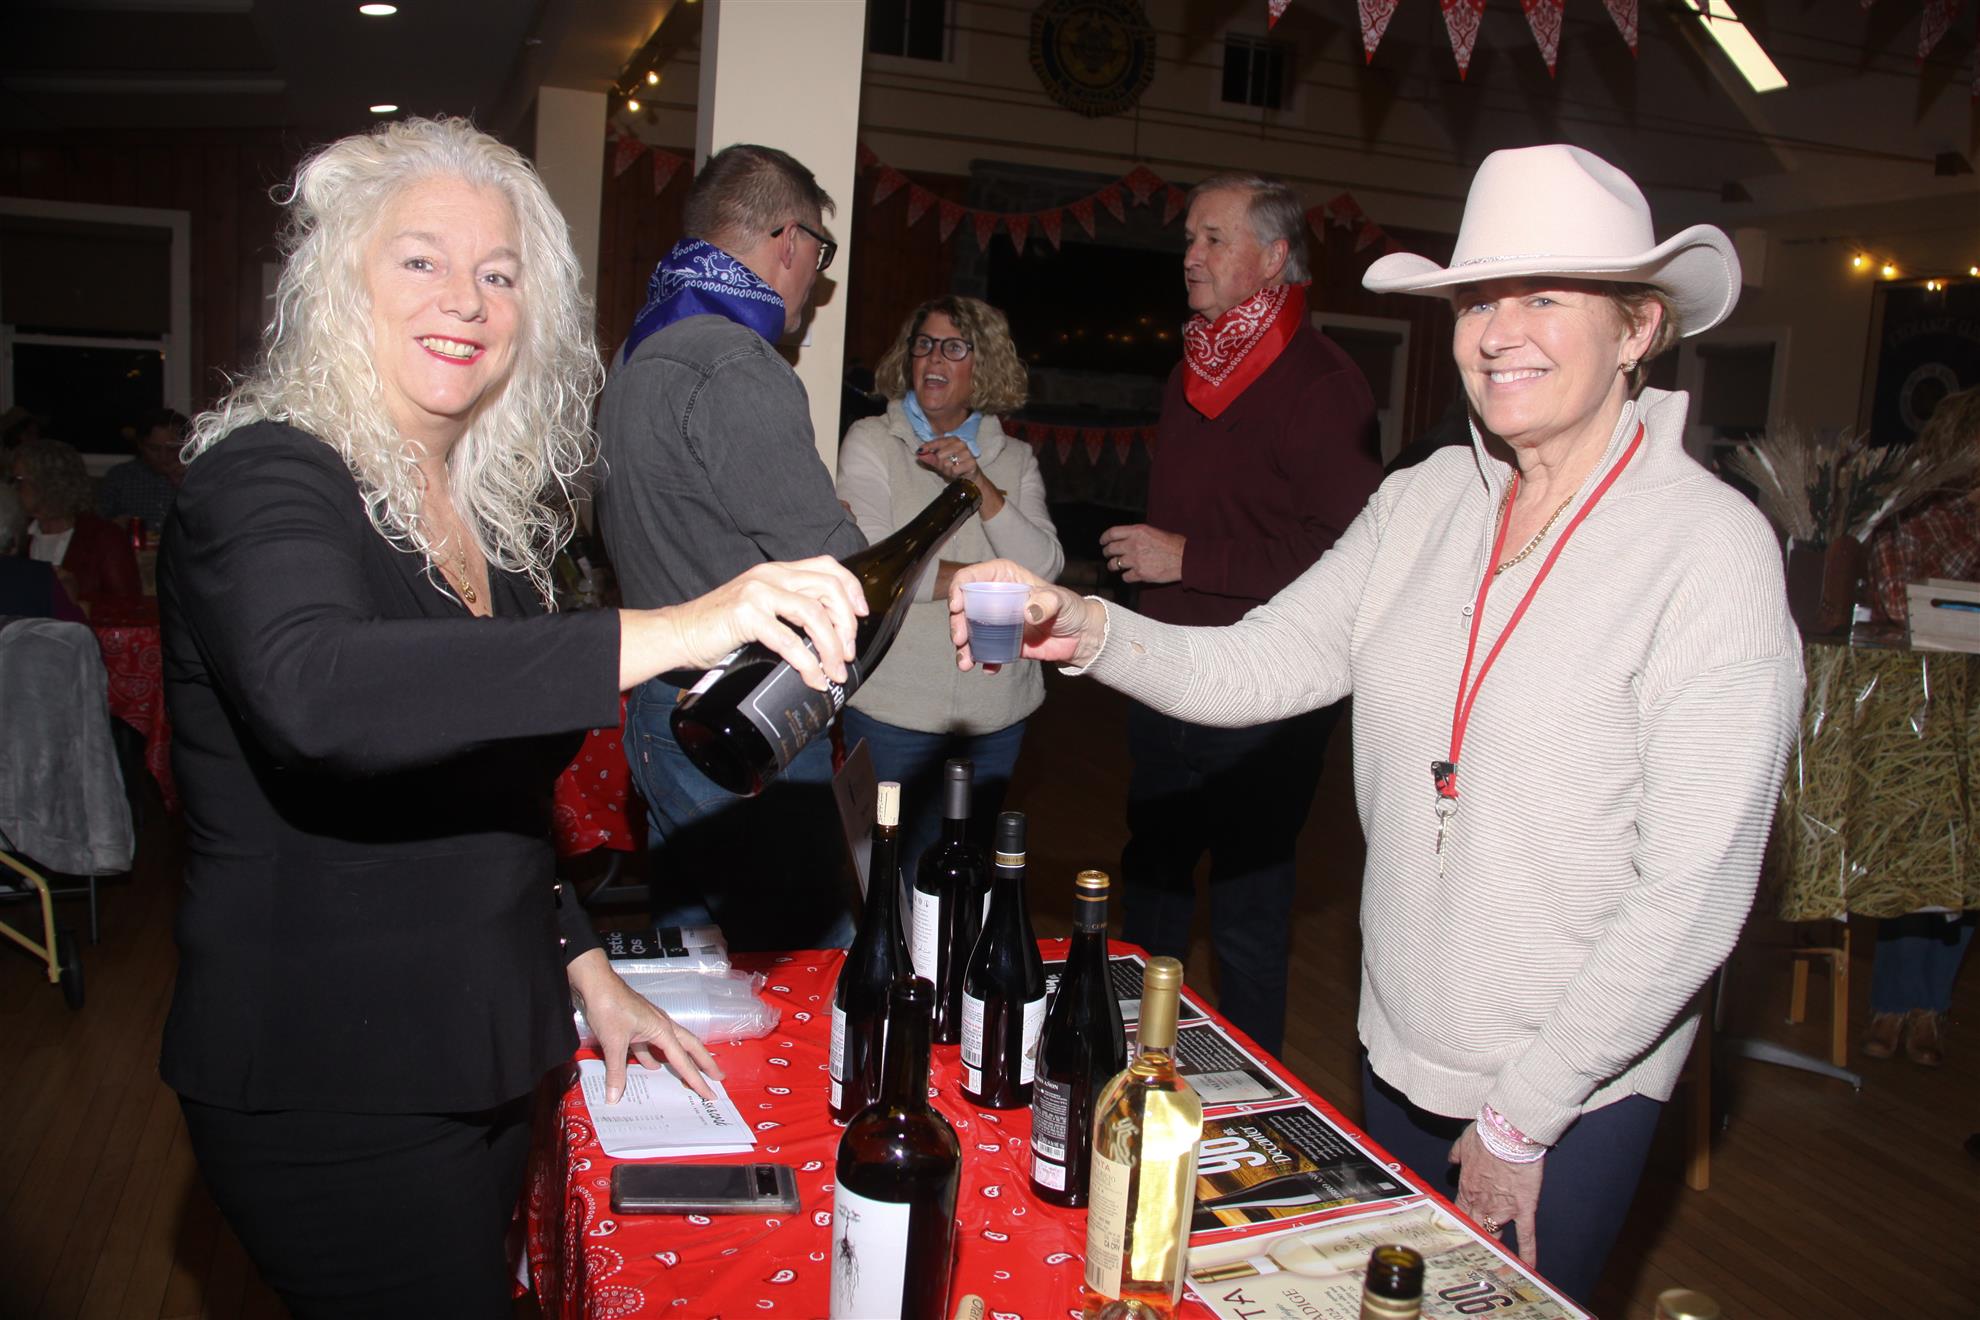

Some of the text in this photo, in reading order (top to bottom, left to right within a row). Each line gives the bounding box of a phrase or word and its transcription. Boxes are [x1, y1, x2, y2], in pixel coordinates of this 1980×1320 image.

[1239, 1125, 1294, 1165] Decanter
[1223, 1287, 1266, 1320] TA
[1438, 1281, 1514, 1315] 90
